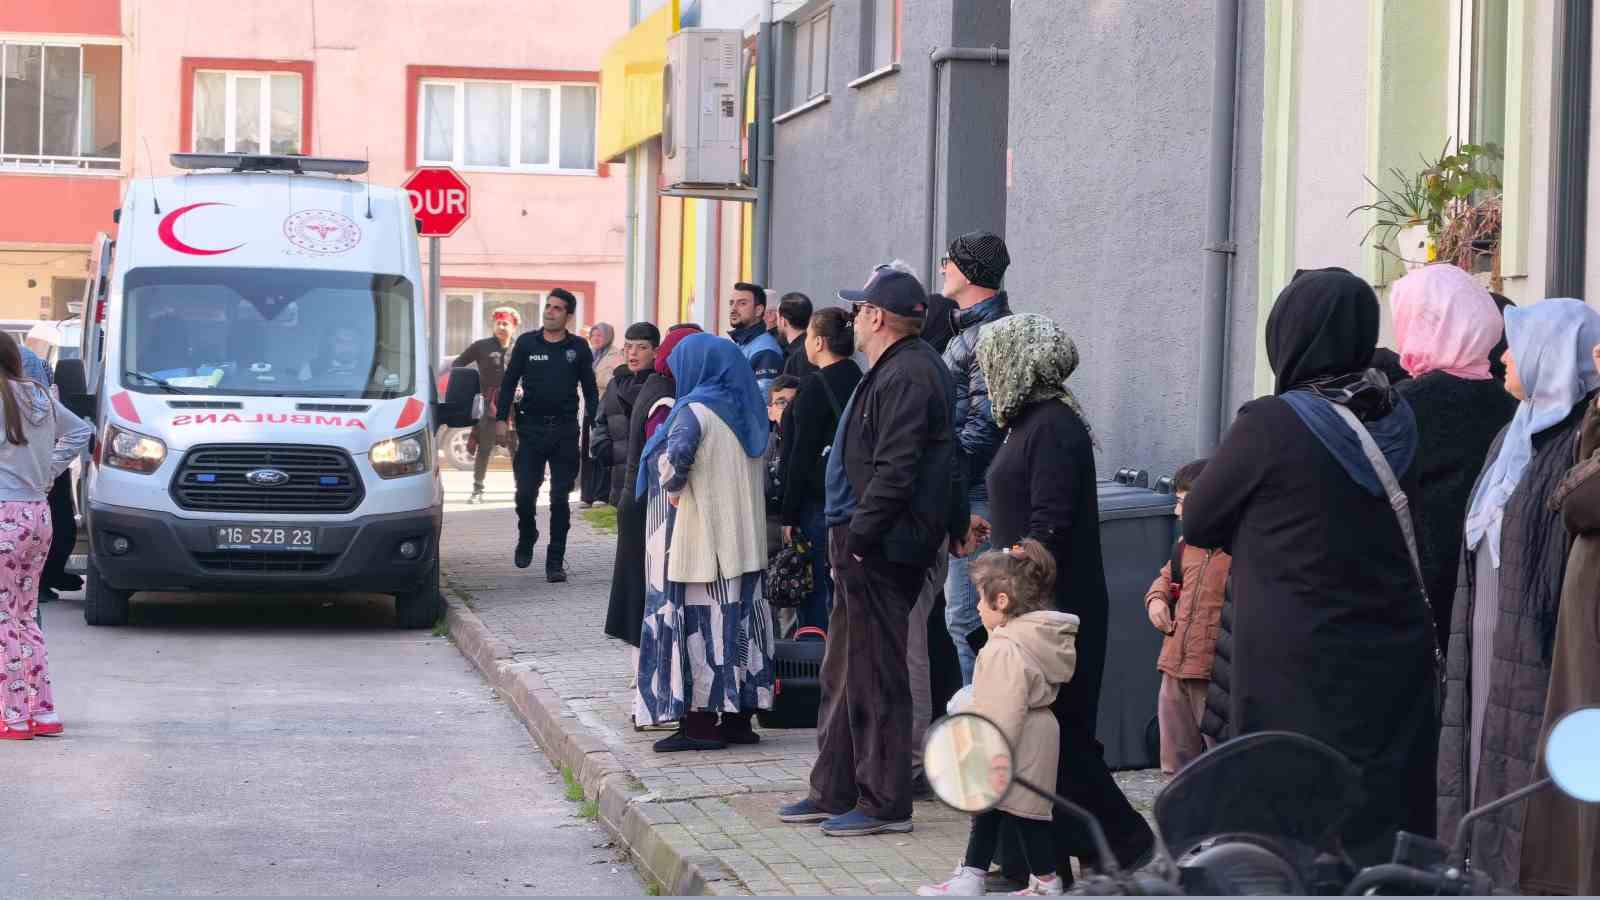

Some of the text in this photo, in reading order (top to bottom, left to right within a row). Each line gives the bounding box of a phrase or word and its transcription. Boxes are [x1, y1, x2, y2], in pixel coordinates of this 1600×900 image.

[256, 471, 281, 483] Ford
[227, 528, 312, 545] 16 SZB 23
